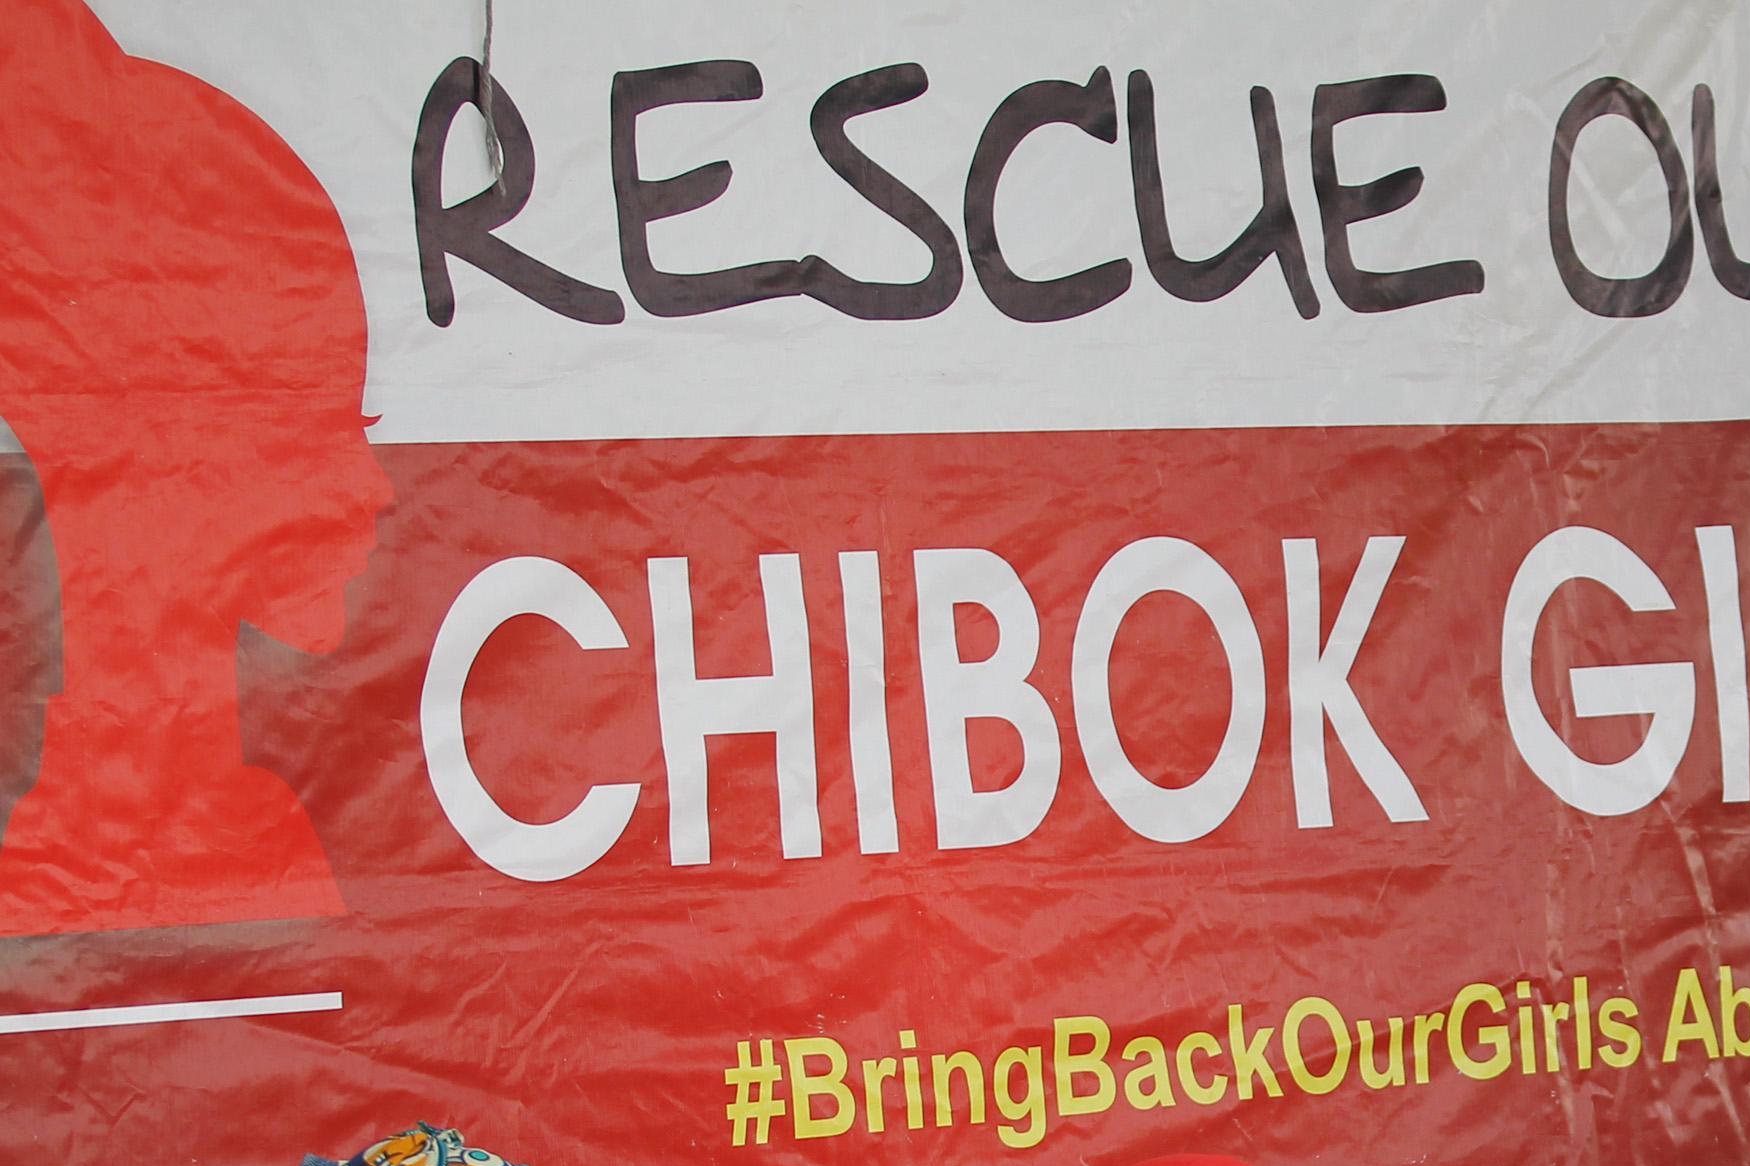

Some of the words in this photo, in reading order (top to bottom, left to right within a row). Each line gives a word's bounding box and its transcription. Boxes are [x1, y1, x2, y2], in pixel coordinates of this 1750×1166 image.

[411, 55, 1486, 328] RESCUE
[419, 535, 1431, 882] CHIBOK
[725, 977, 1642, 1148] #BringBackOurGirls
